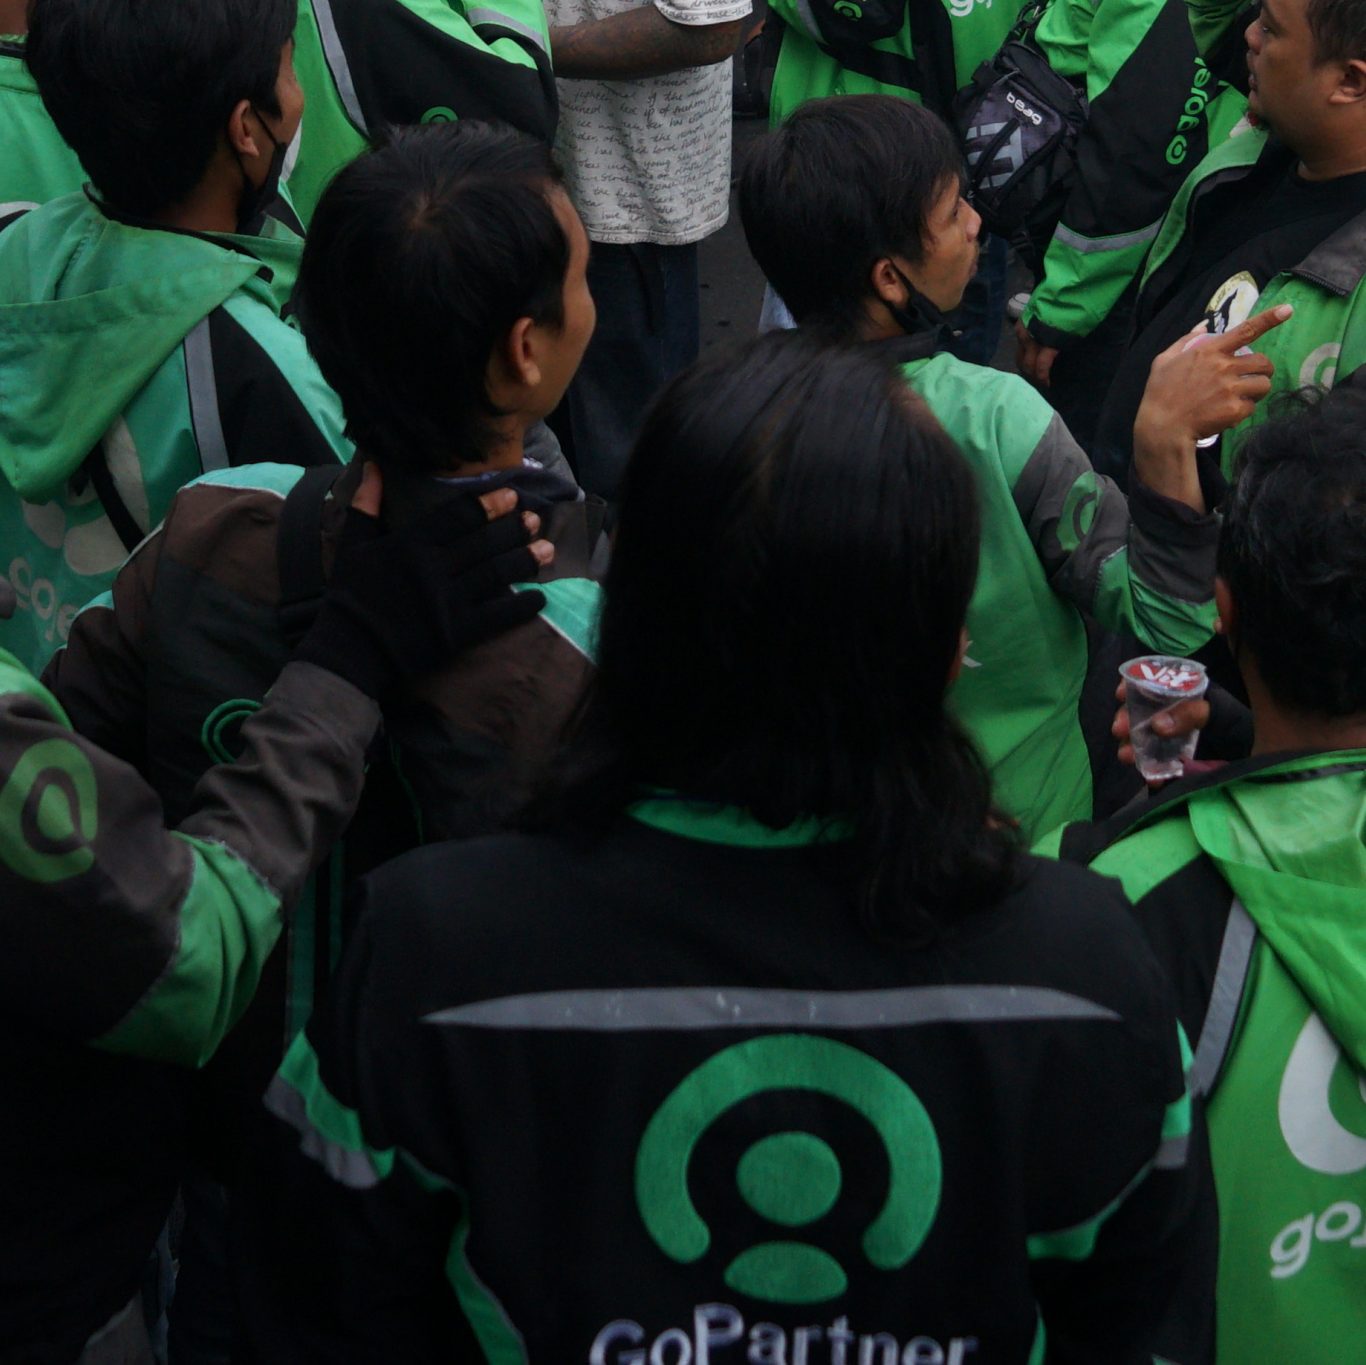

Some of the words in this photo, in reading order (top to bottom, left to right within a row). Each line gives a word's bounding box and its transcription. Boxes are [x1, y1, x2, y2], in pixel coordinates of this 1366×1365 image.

[1176, 56, 1211, 132] goje
[8, 556, 80, 644] goje
[590, 1302, 978, 1365] GoPartner
